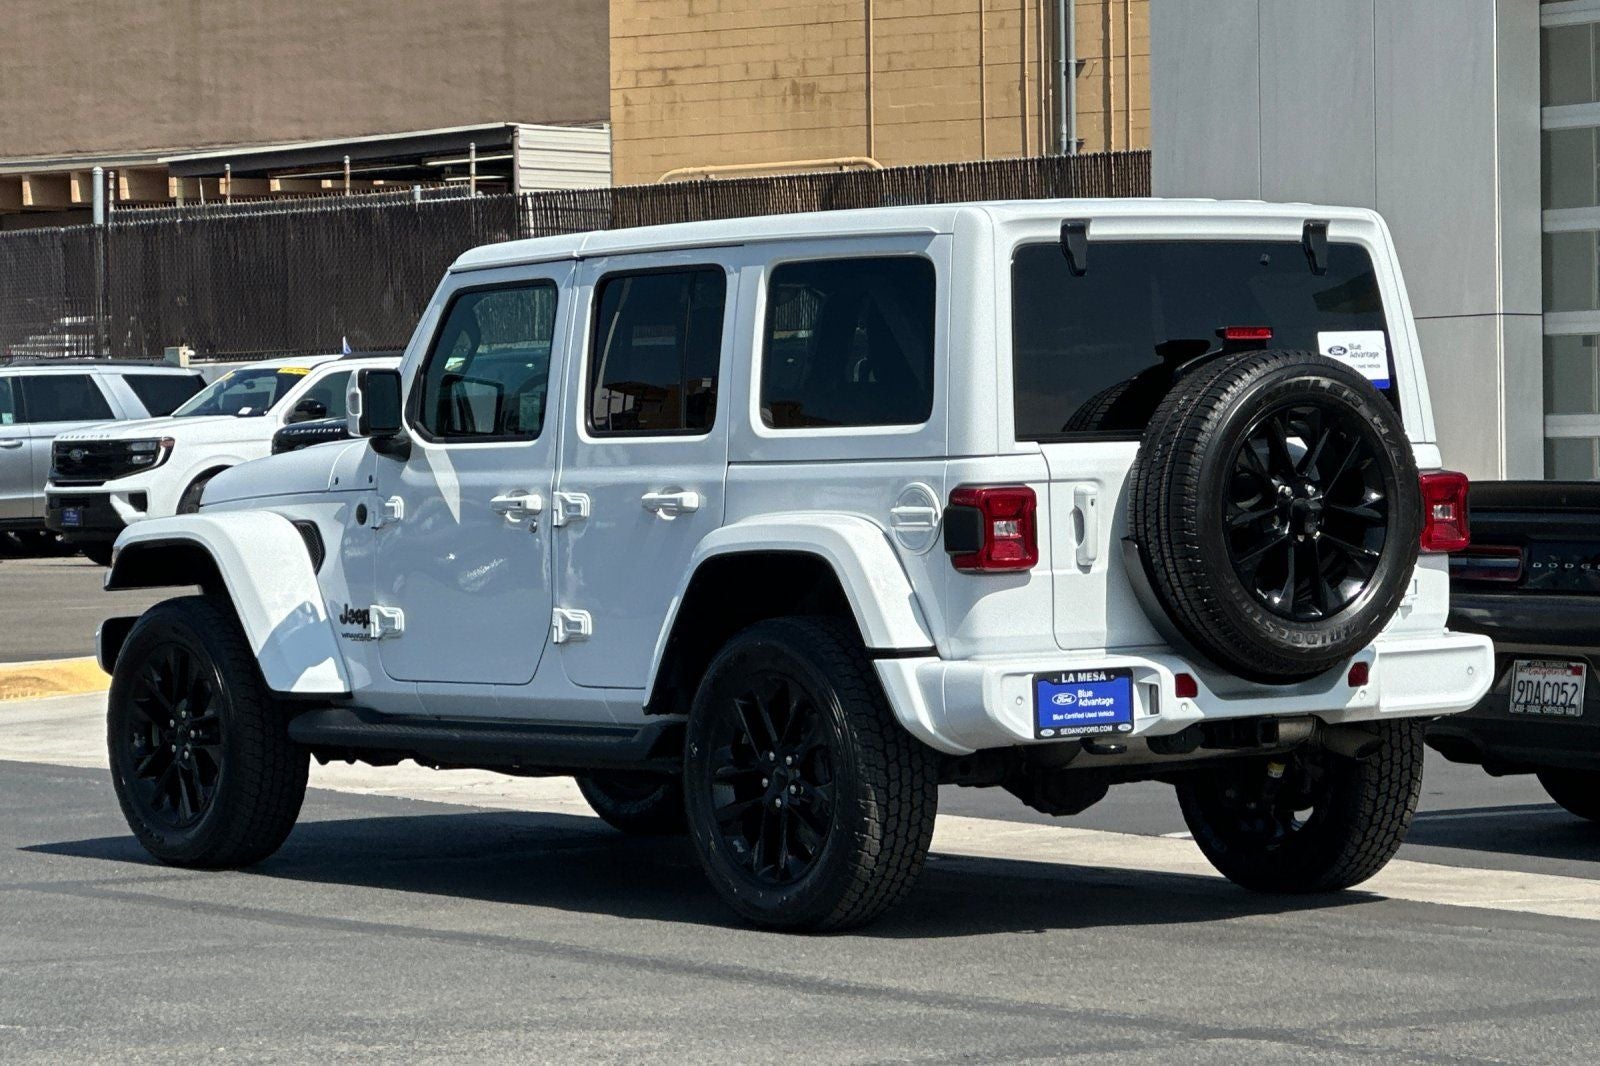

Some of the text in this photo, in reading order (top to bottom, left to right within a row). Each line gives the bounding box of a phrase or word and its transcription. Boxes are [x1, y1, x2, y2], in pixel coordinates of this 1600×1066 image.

[1348, 343, 1362, 351] Blue
[1349, 351, 1379, 360] Advantage
[339, 603, 370, 629] Jeep
[1061, 671, 1107, 683] LA MESA
[1077, 689, 1093, 698] Blue
[1516, 680, 1578, 708] 9DAC052
[1078, 697, 1114, 707] Advantage
[1052, 713, 1064, 721] Blue
[1064, 712, 1085, 720] Certified
[1060, 725, 1113, 736] SEDANOFORD.COM
